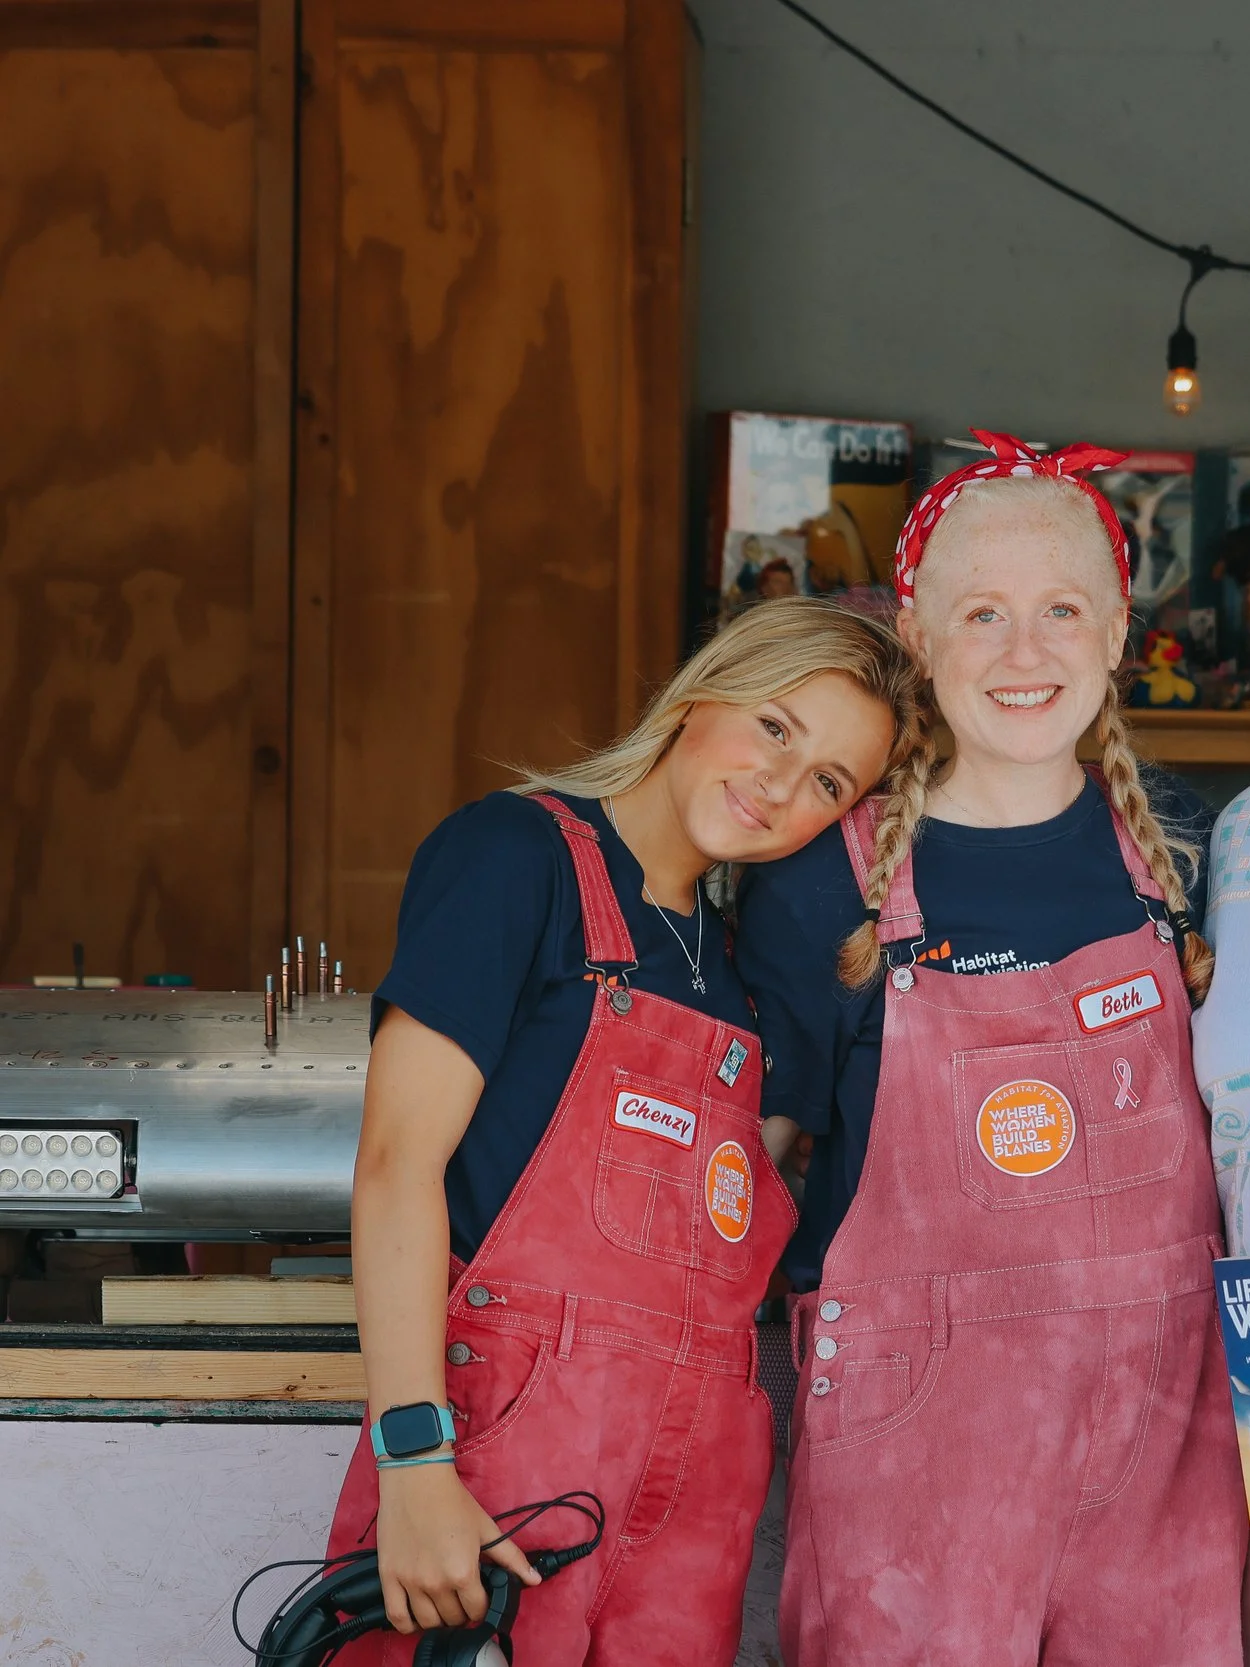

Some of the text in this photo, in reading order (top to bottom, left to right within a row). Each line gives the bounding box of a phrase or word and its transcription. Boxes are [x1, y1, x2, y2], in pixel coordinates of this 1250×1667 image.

[839, 430, 871, 463] Do
[952, 949, 1017, 974] Habitat
[1102, 986, 1143, 1018] Beth
[622, 1098, 691, 1138] Chenzy
[989, 1104, 1046, 1121] WHERE
[991, 1114, 1056, 1133] WOMEN
[995, 1086, 1070, 1149] HABITAT for AVIATION
[992, 1130, 1038, 1147] BUILD
[994, 1140, 1052, 1158] PLANES
[715, 1163, 744, 1186] WHERE
[713, 1187, 737, 1207] BUILD
[715, 1175, 746, 1199] WOMEN
[712, 1200, 741, 1224] PLANES
